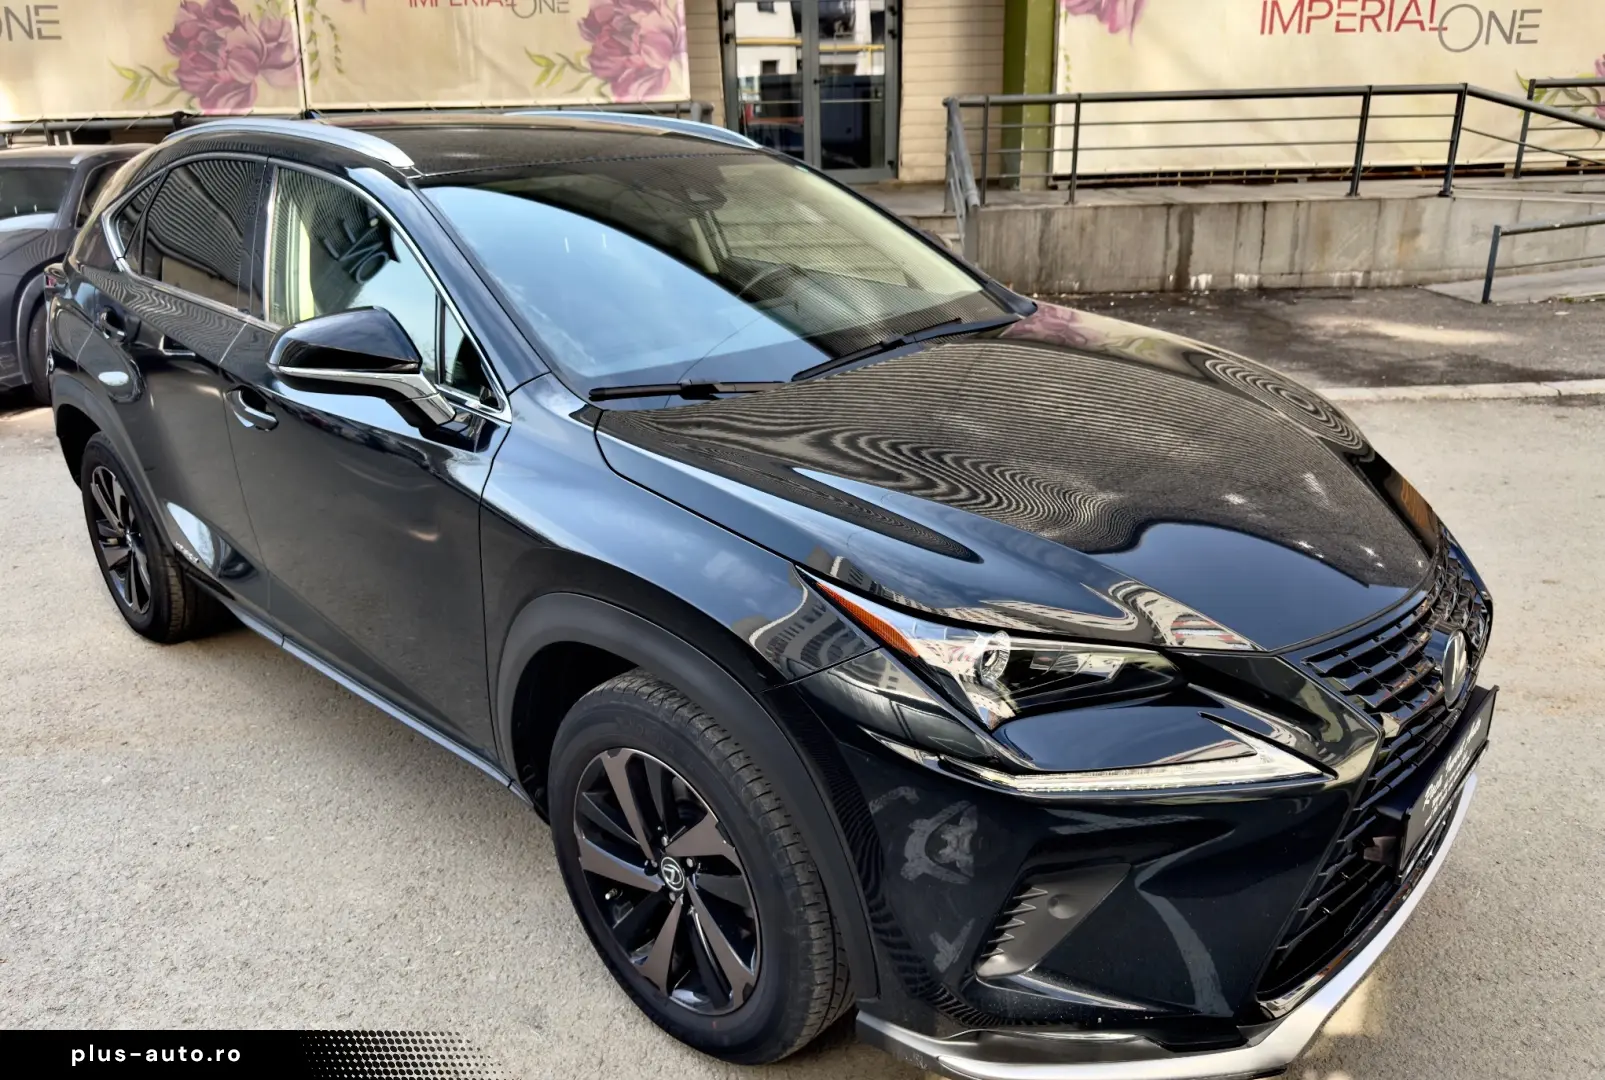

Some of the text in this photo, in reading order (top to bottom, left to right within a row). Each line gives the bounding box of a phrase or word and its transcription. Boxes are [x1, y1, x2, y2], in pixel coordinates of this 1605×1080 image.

[0, 5, 62, 41] NE
[1260, 0, 1543, 53] IMPERIAL ONE
